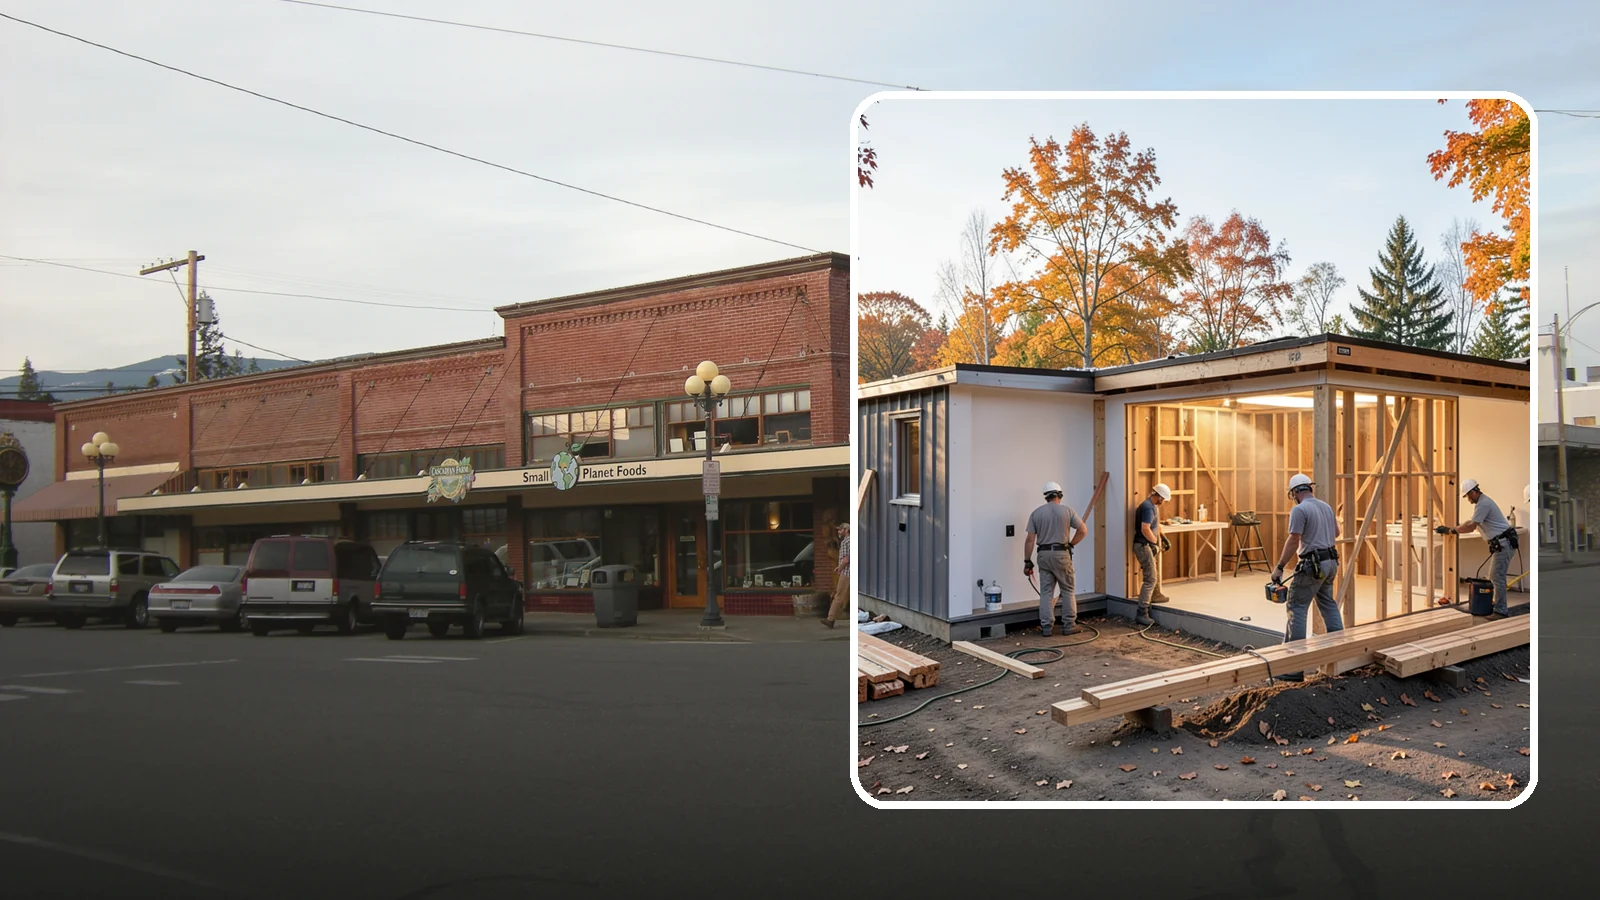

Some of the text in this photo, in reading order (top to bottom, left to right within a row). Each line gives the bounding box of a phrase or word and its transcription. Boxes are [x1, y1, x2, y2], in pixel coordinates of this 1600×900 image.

[523, 464, 647, 483] Small Planet Foods
